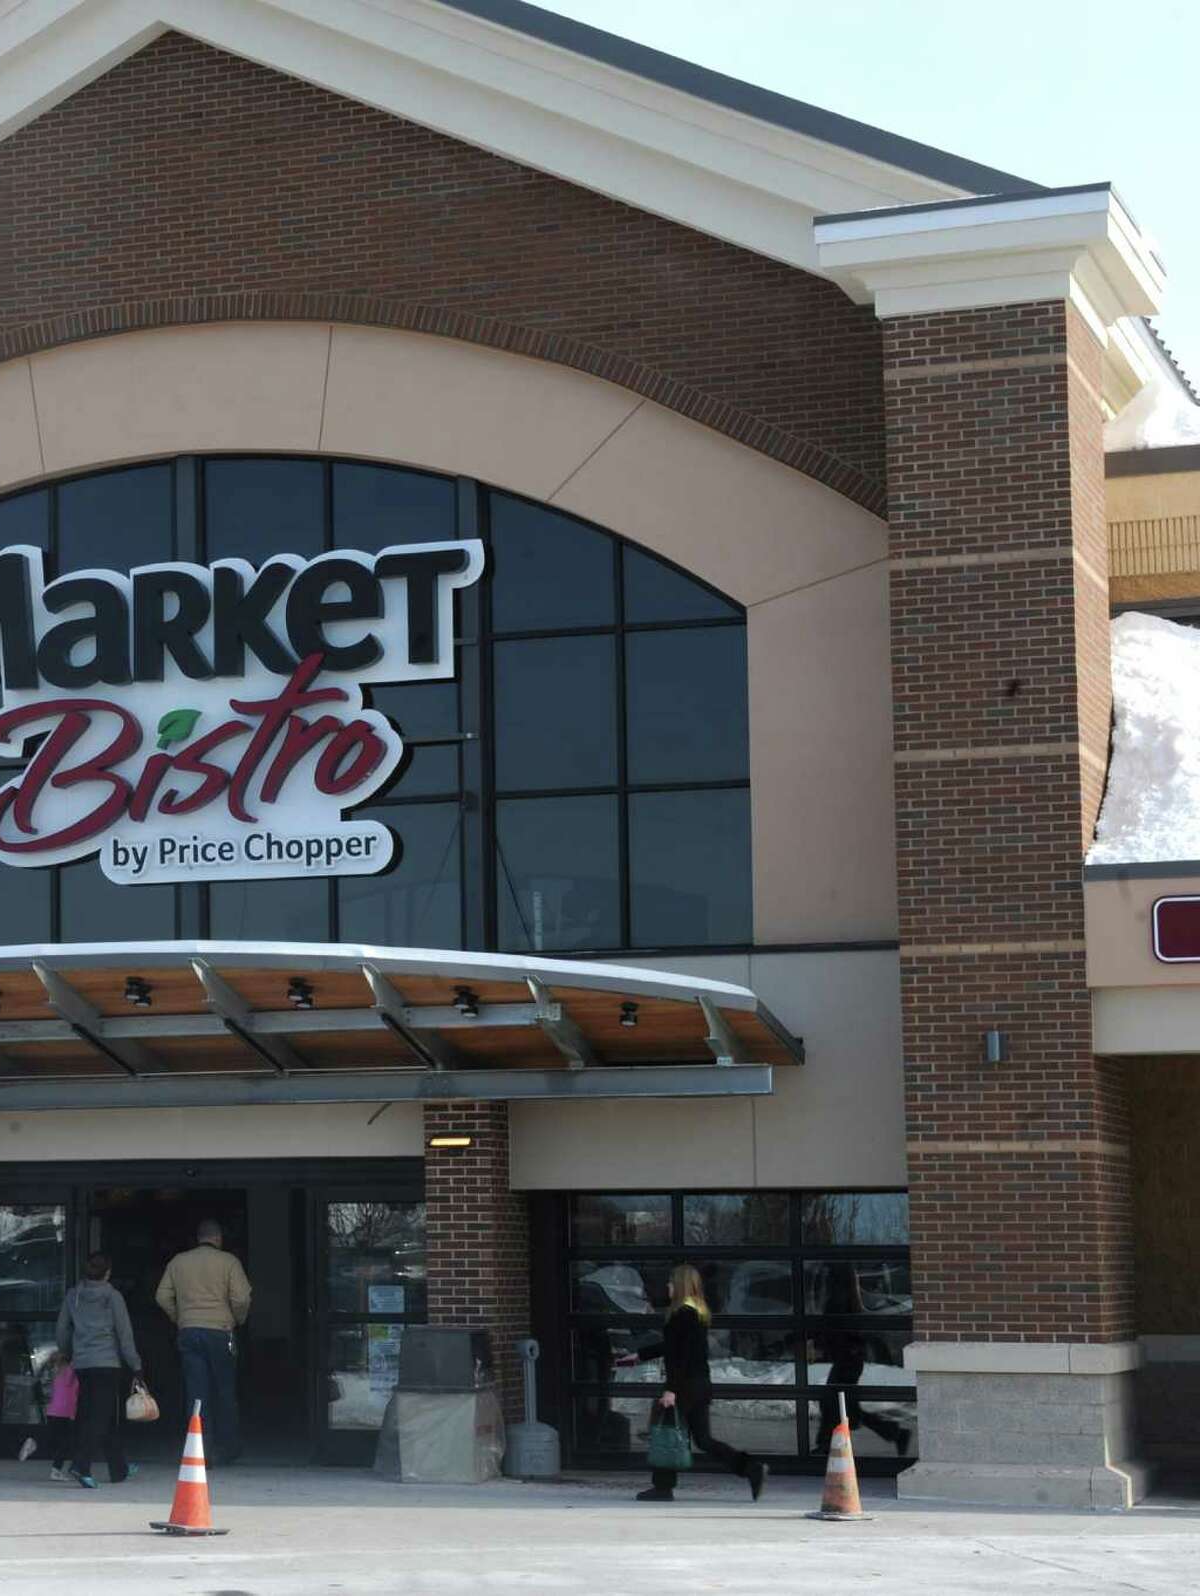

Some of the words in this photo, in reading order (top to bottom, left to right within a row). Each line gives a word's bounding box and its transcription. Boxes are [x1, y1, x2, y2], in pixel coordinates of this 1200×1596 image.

[111, 838, 149, 874] by
[158, 835, 235, 865] Price
[243, 831, 378, 867] Chopper
